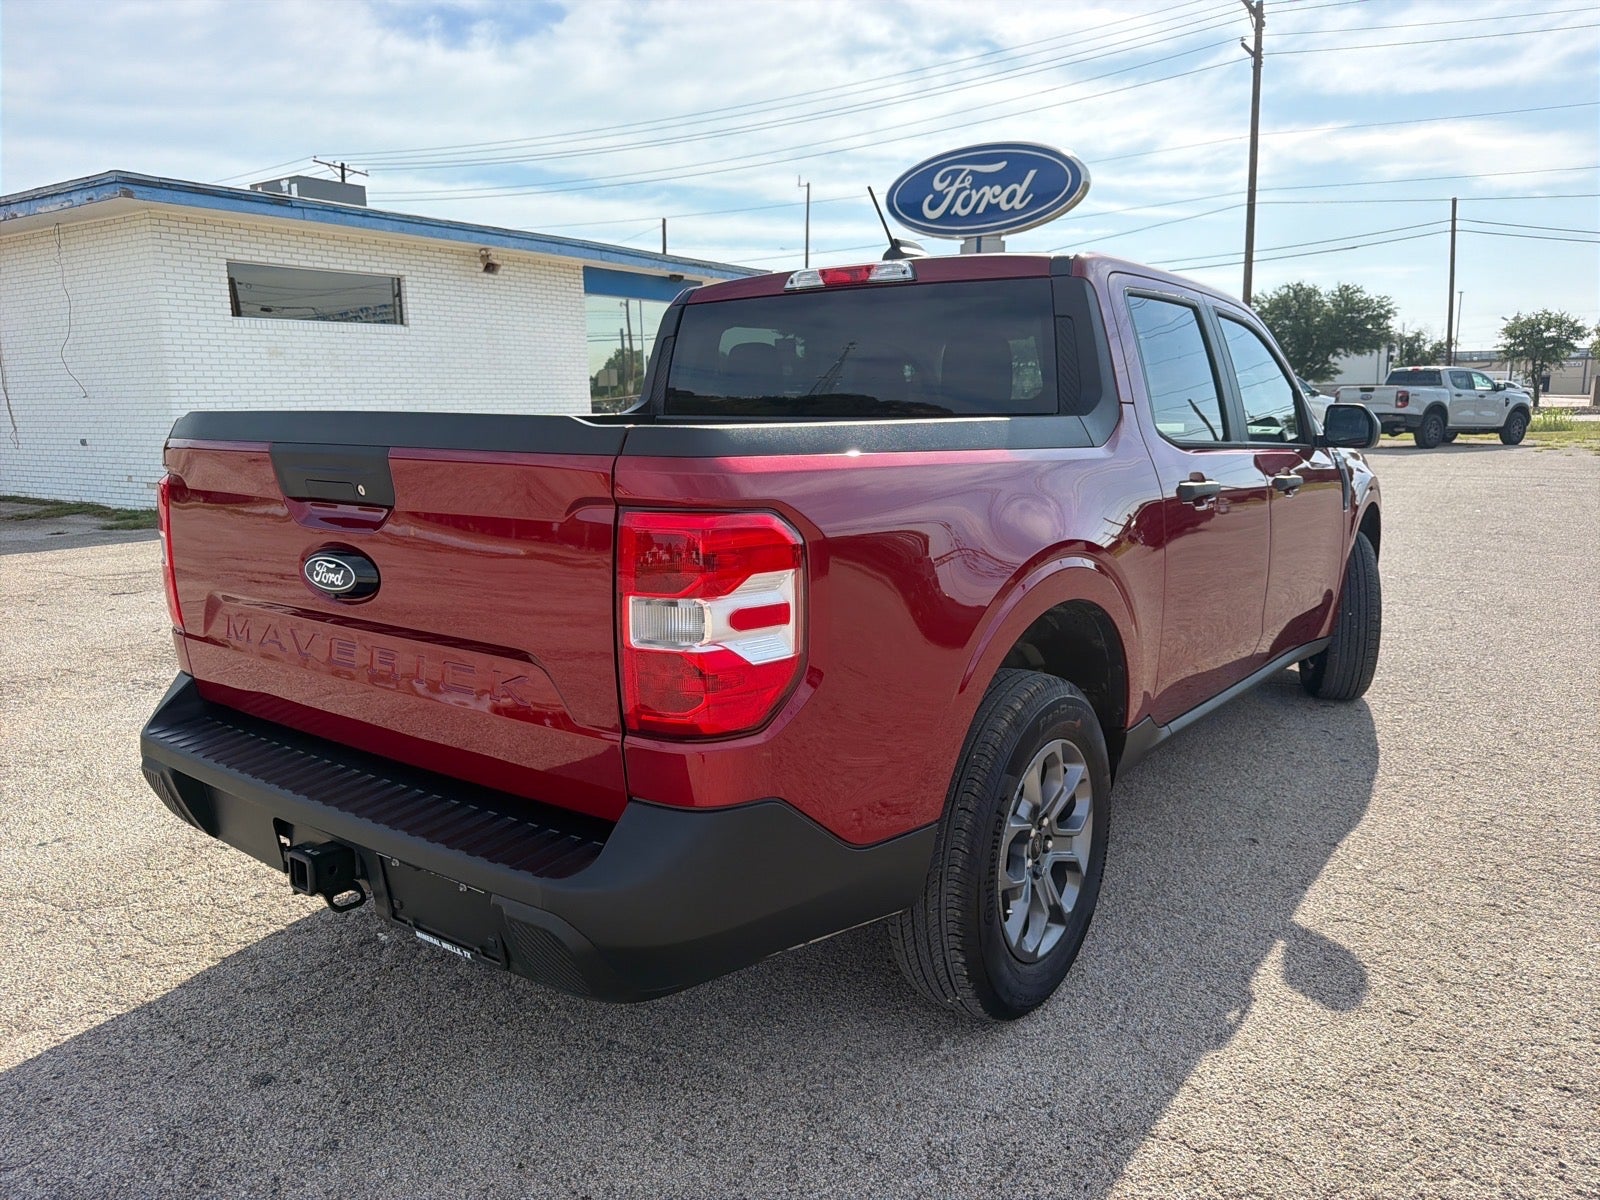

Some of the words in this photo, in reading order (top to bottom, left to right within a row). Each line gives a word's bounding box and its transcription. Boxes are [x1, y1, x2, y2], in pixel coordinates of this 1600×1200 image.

[922, 160, 1038, 219] Ford
[313, 560, 344, 586] Ford
[225, 614, 530, 706] MAVERICK
[415, 930, 441, 947] MINERAL
[462, 950, 472, 960] TX
